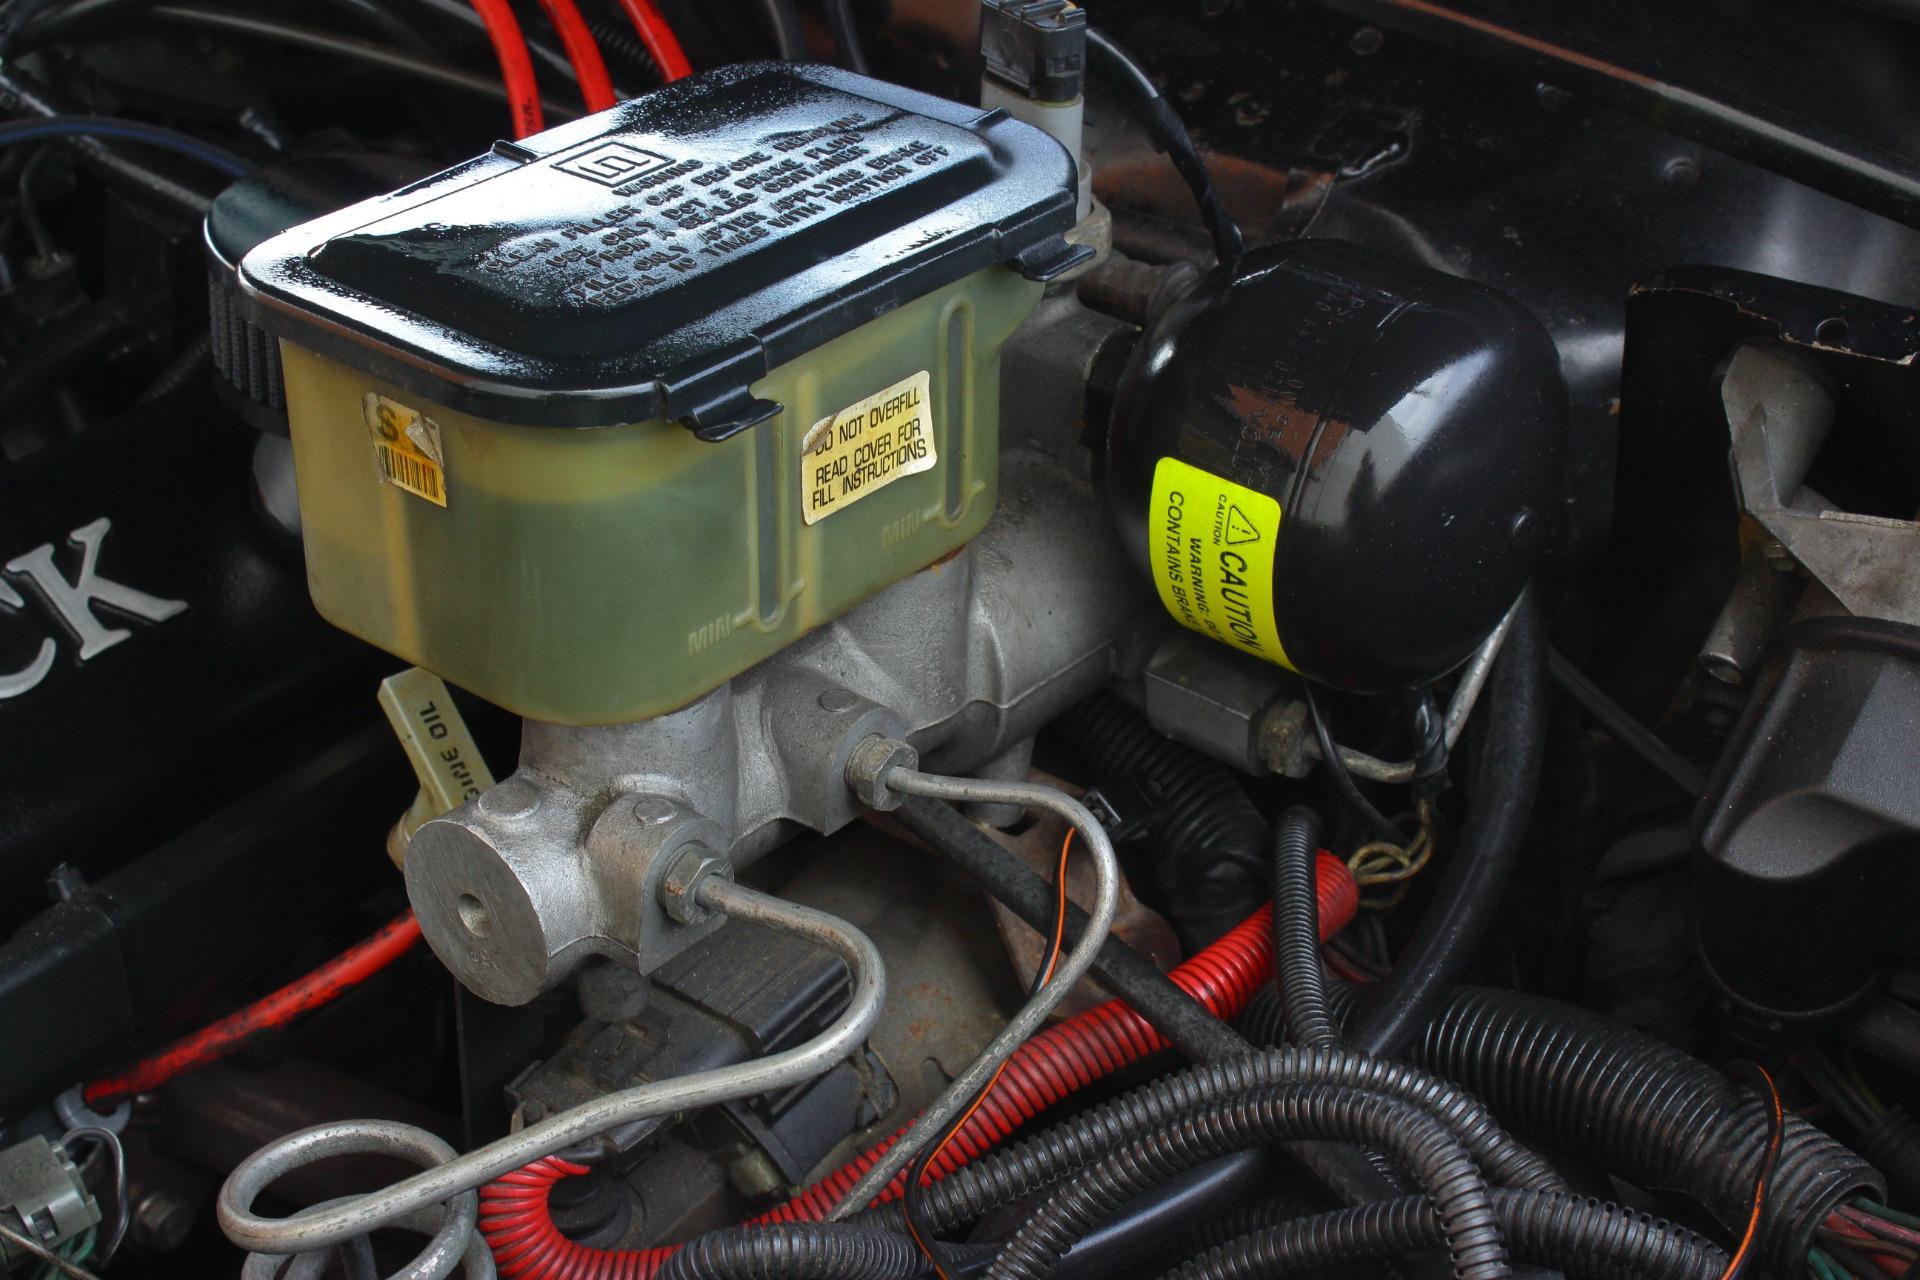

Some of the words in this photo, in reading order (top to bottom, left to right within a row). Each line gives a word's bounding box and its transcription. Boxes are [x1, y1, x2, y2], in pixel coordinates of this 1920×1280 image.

[485, 238, 559, 272] CLEAN
[561, 205, 642, 240] FILLER
[646, 184, 685, 206] CAP
[690, 152, 772, 186] BEFORE
[772, 112, 866, 152] REMOVING
[547, 244, 597, 268] USE
[601, 221, 656, 245] ONLY
[660, 197, 706, 220] DOT
[711, 187, 732, 199] 3
[735, 158, 804, 190] BRAKE
[803, 131, 865, 160] FLUID
[586, 238, 651, 268] FROM
[655, 229, 676, 241] A
[678, 192, 758, 229] SEALED
[762, 145, 870, 193] CONTAINER
[612, 159, 703, 197] WARNING
[570, 273, 630, 299] FILL
[634, 244, 689, 271] ONLY
[698, 211, 767, 244] AFTER
[769, 168, 864, 213] APPLYING
[864, 140, 933, 170] BRAKE
[588, 274, 667, 308] PEDAL
[669, 256, 697, 272] 10
[702, 226, 770, 257] TIMES
[767, 203, 825, 228] WITH
[825, 164, 912, 204] IGNITION
[912, 145, 948, 166] OFF
[815, 456, 848, 487] READ
[854, 432, 891, 468] COVER
[898, 417, 921, 446] FOR
[839, 415, 864, 442] NOT
[870, 387, 920, 429] OVERFILL
[812, 485, 835, 511] FILL
[842, 438, 927, 495] INSTRUCTIONS
[1166, 490, 1184, 584] CONTAINS
[1212, 494, 1227, 546] CAUTION
[1185, 537, 1210, 616] WARNING:
[1219, 550, 1266, 652] CAUTION
[687, 612, 734, 657] MIN
[419, 700, 448, 740] OIL
